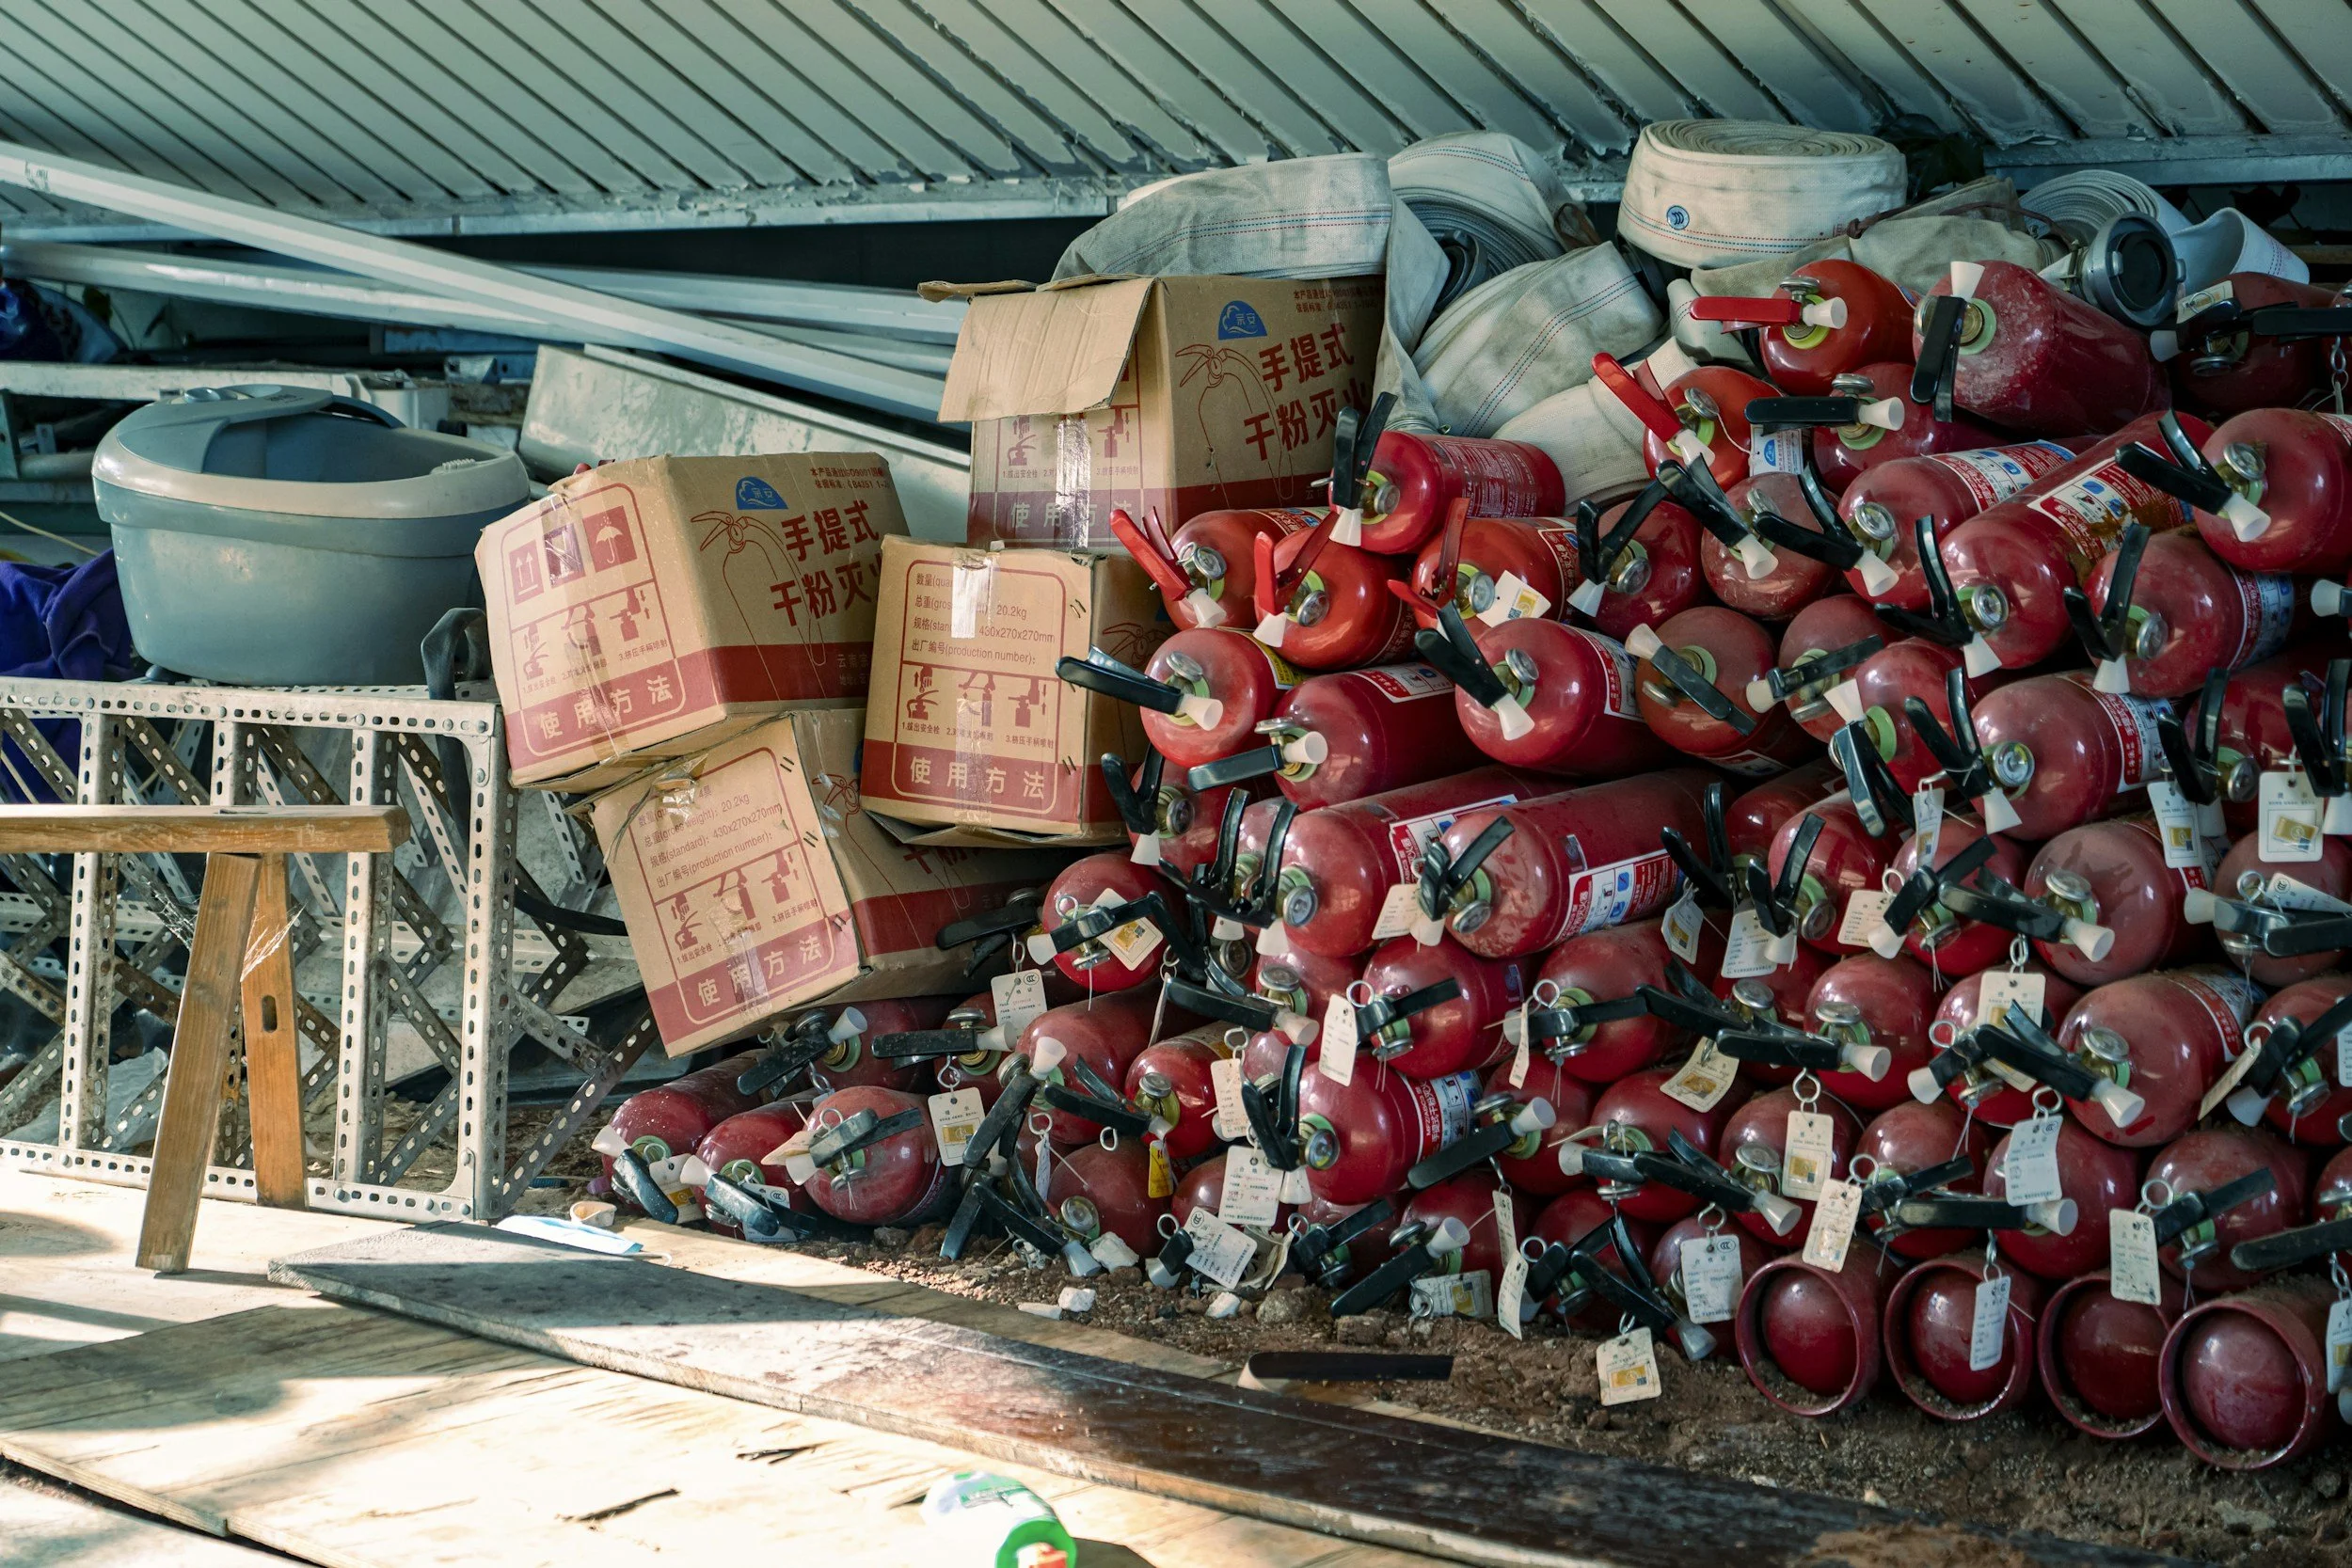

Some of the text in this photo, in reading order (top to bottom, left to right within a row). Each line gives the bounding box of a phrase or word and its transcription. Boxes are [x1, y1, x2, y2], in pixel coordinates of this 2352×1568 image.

[1259, 322, 1355, 393] 手提式
[781, 499, 880, 562] 手提式
[978, 625, 1056, 644] 430x270x270mm
[996, 604, 1027, 621] 20.2kg
[539, 674, 674, 740] 使用方法
[910, 755, 1045, 800] 使用方法
[721, 792, 751, 813] 20.2kg
